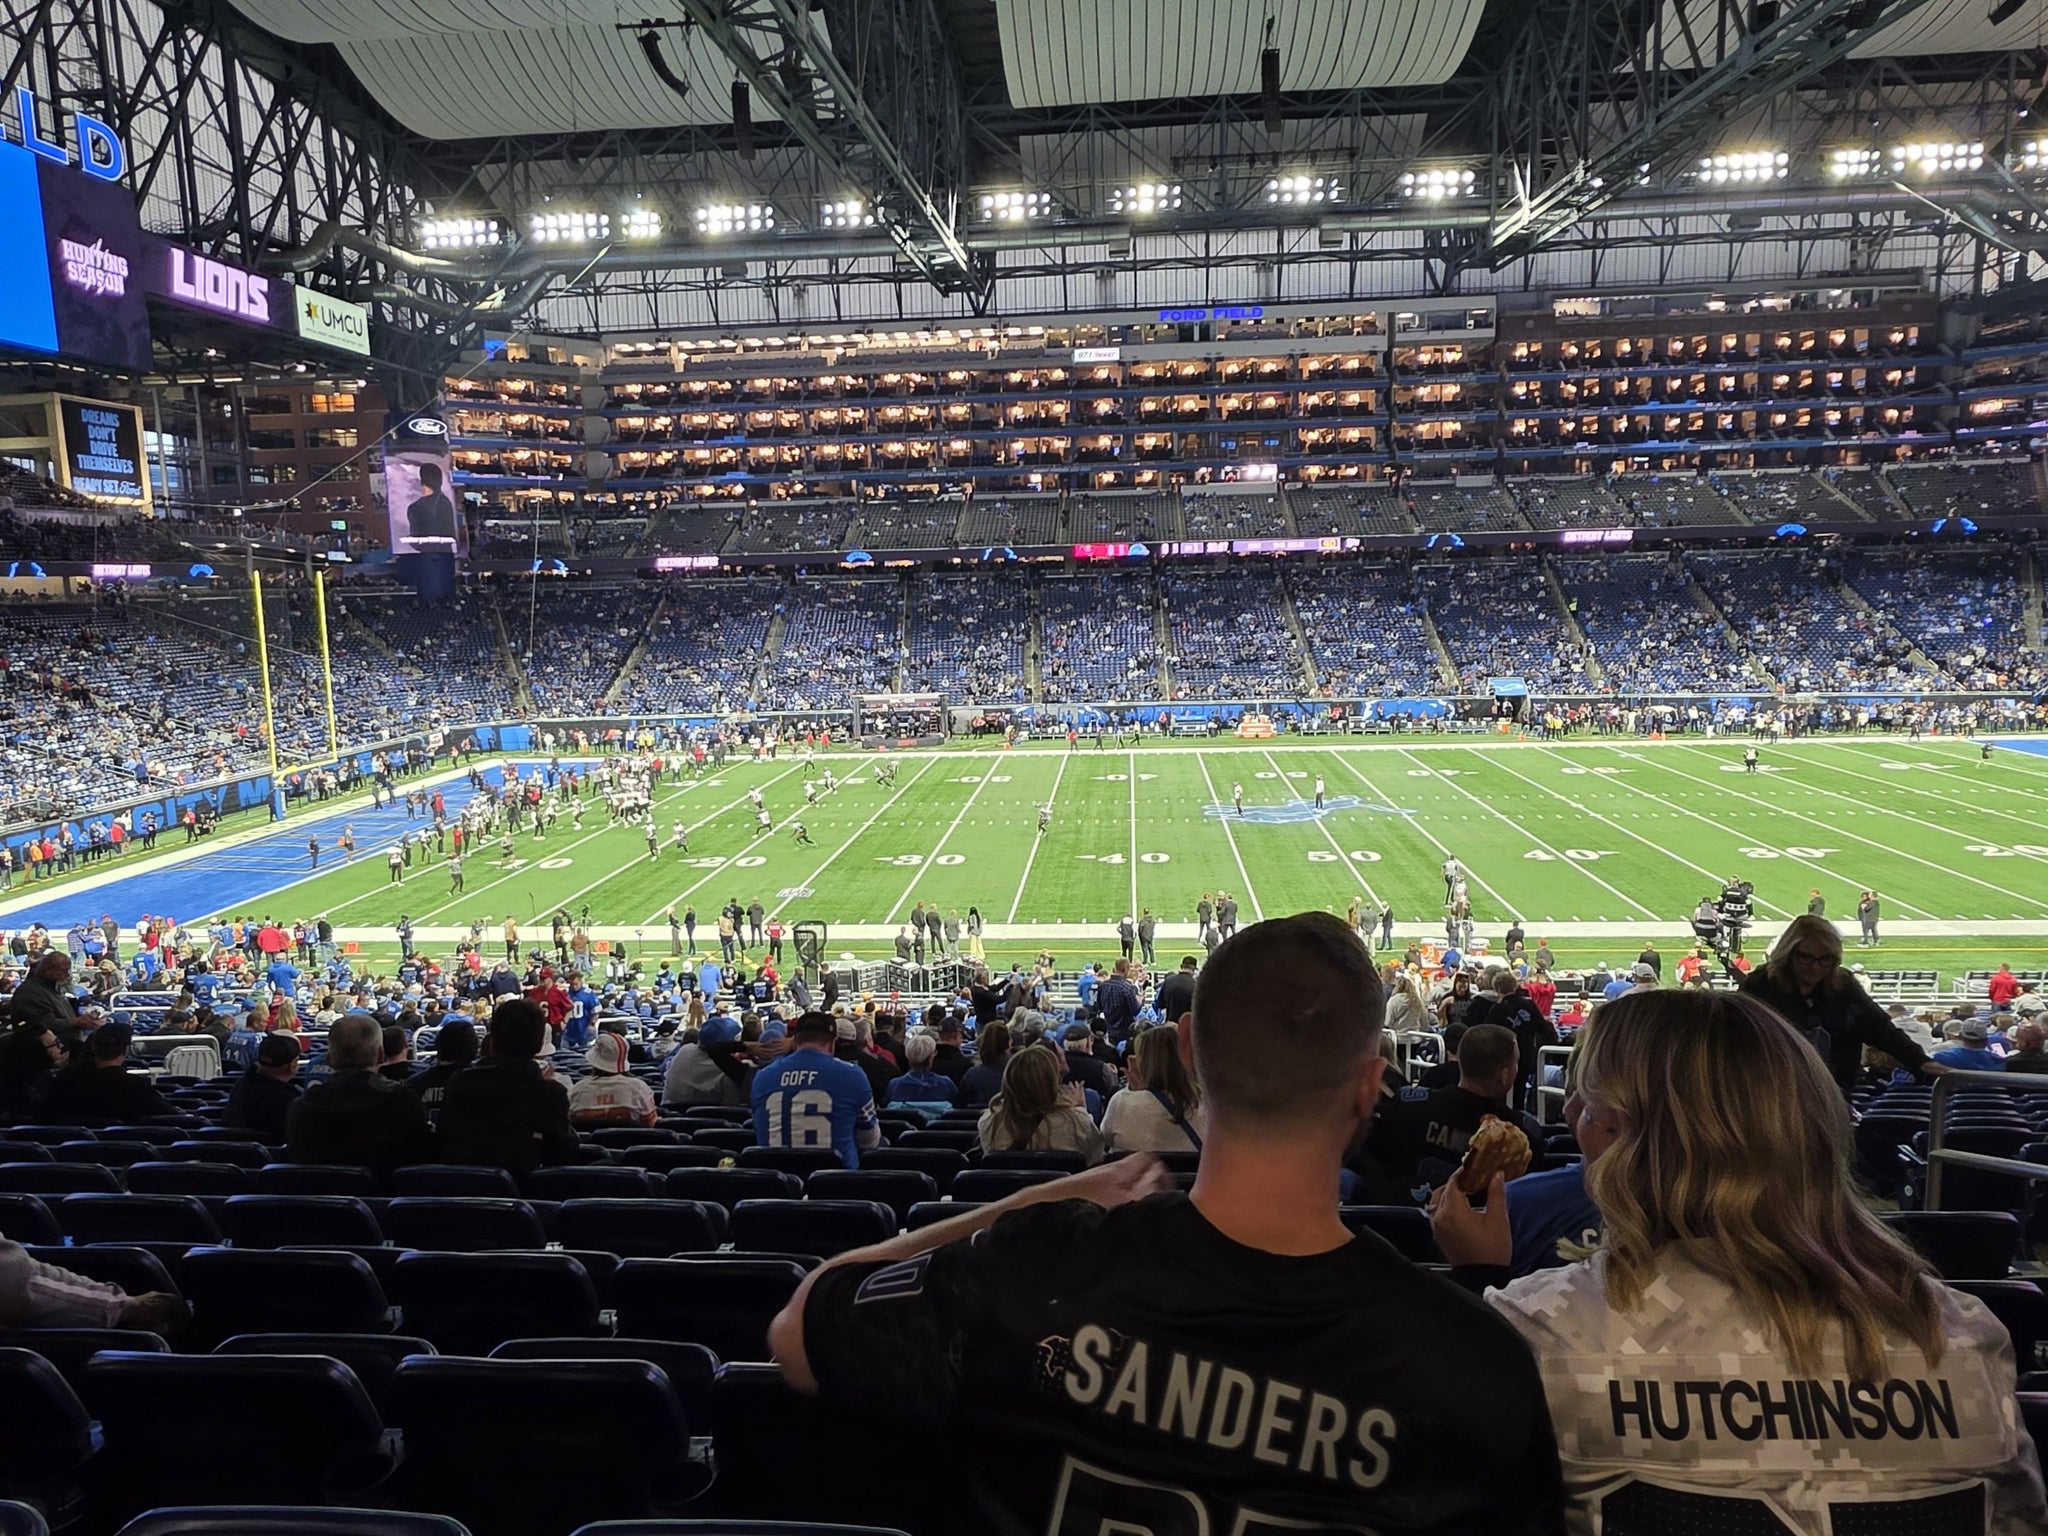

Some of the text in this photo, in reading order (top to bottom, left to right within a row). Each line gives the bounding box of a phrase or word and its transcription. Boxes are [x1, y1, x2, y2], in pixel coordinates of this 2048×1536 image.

[0, 85, 124, 181] LD
[61, 238, 128, 277] HUNTING
[67, 260, 125, 295] SEASON
[171, 247, 270, 322] LIONS
[321, 306, 363, 337] UMCU
[1160, 306, 1263, 321] FORD FIELD
[81, 408, 119, 427] DREAMS
[77, 454, 134, 474] THEMSELVES
[132, 785, 228, 836] CITY
[892, 854, 966, 866] 30
[1098, 853, 1170, 864] 40
[1307, 850, 1382, 862] 50
[1524, 849, 1600, 861] 40
[1738, 846, 1826, 858] 30
[1963, 844, 2048, 857] 20
[690, 856, 767, 868] 20
[780, 1070, 819, 1087] GOFF
[766, 1089, 833, 1149] 16
[1064, 1323, 1397, 1490] SANDERS
[1607, 1378, 1960, 1441] HUTCHINSON
